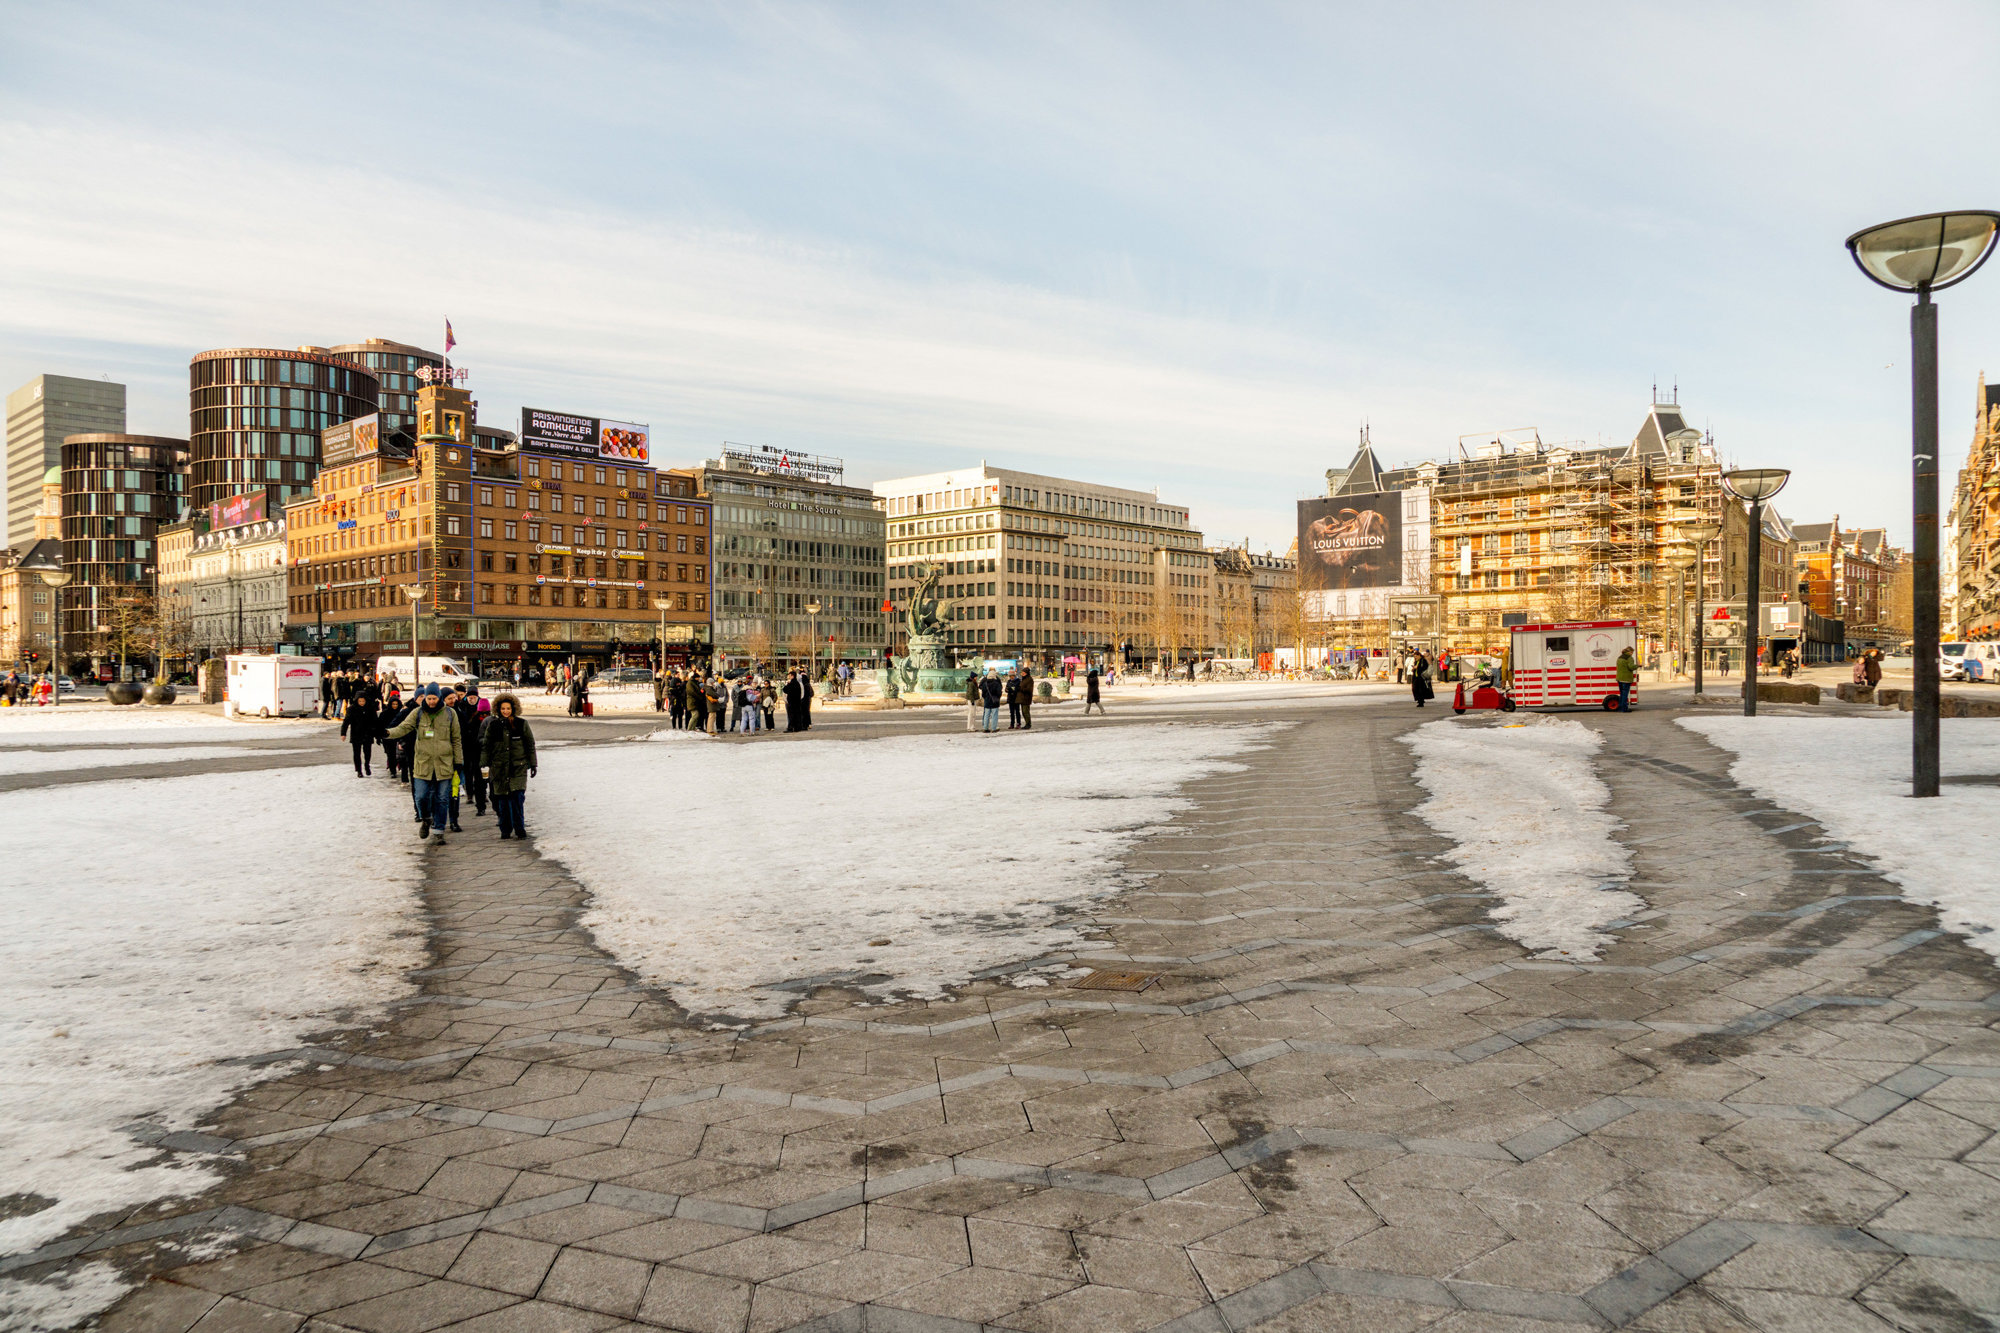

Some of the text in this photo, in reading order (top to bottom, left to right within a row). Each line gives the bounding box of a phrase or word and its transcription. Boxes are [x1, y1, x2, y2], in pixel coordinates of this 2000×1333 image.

[252, 350, 317, 361] GORRISSEN
[433, 368, 468, 380] THAI
[532, 412, 592, 427] PRISVINDENDE
[532, 420, 592, 436] ROMKUGLER
[769, 446, 808, 459] The Square
[768, 500, 842, 515] Hotel The Square
[1314, 538, 1340, 550] LOUIS
[1343, 536, 1384, 547] VUITTON
[576, 548, 590, 556] Keep
[395, 668, 432, 676] TEXTLIA
